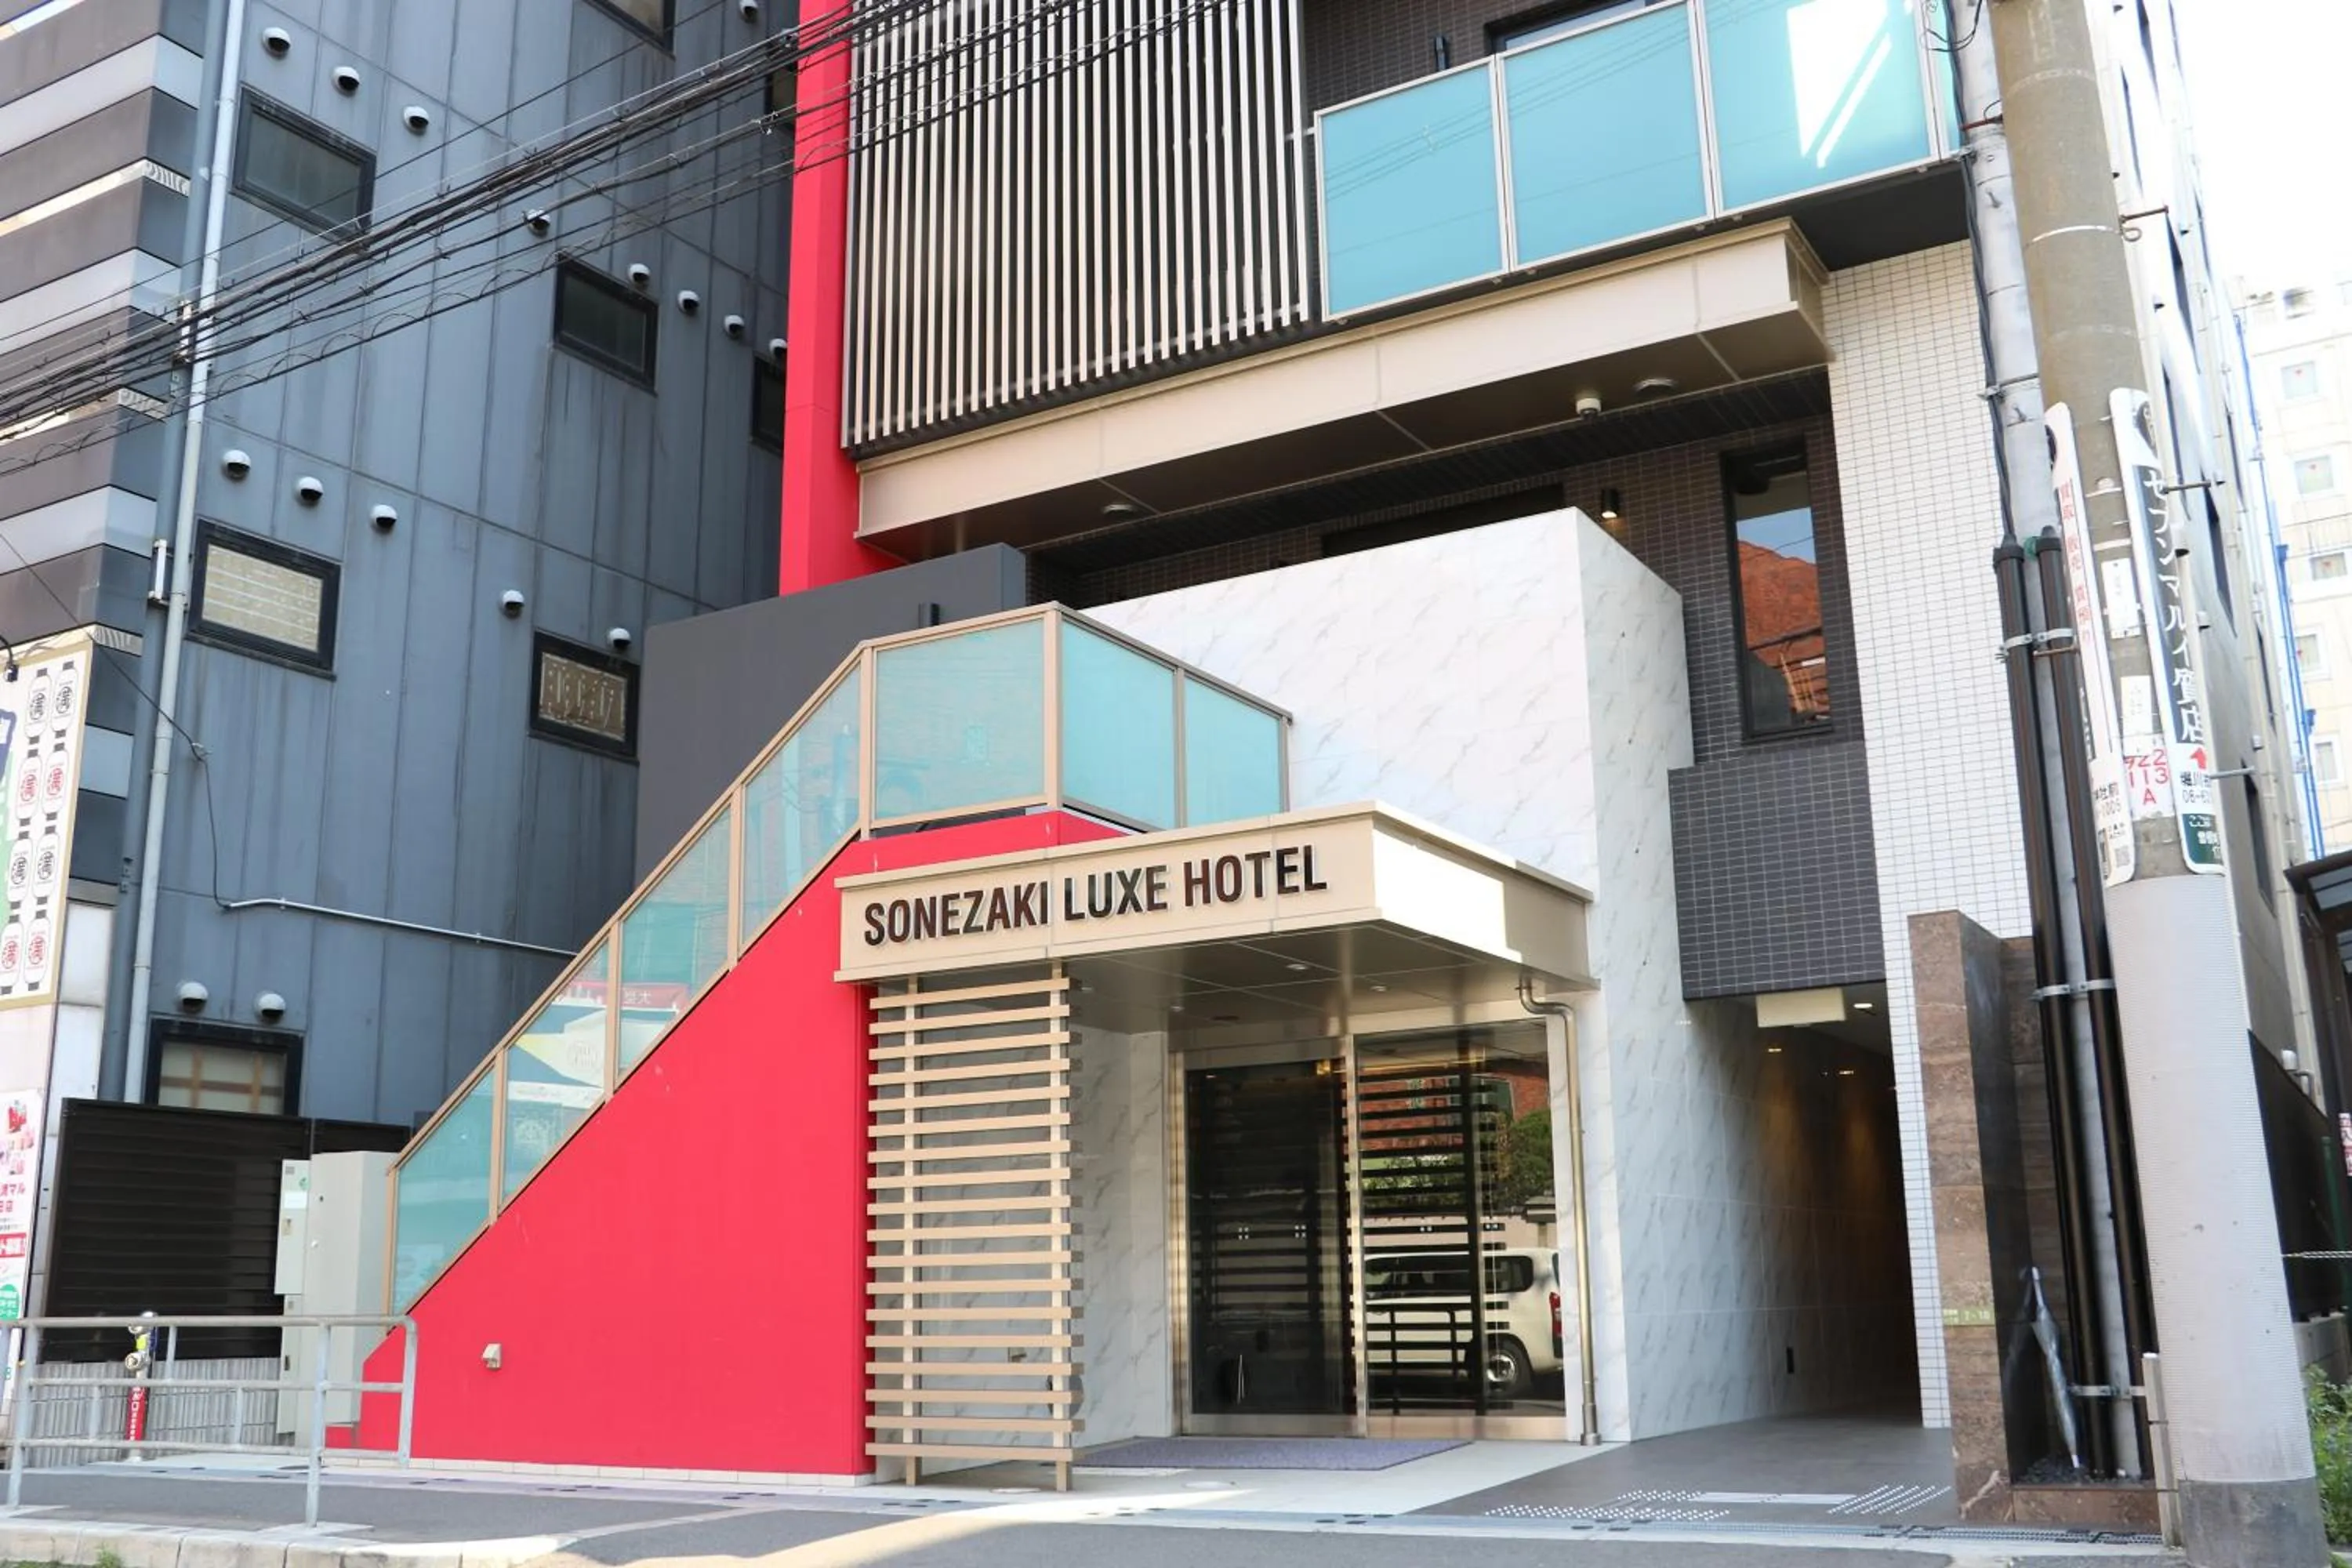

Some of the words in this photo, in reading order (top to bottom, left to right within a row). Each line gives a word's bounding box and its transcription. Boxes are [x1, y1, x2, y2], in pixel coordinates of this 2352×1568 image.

[2143, 787, 2157, 805] A
[864, 881, 1049, 946] SONEZAKI
[1064, 865, 1168, 921] LUXE
[1183, 844, 1328, 908] HOTEL
